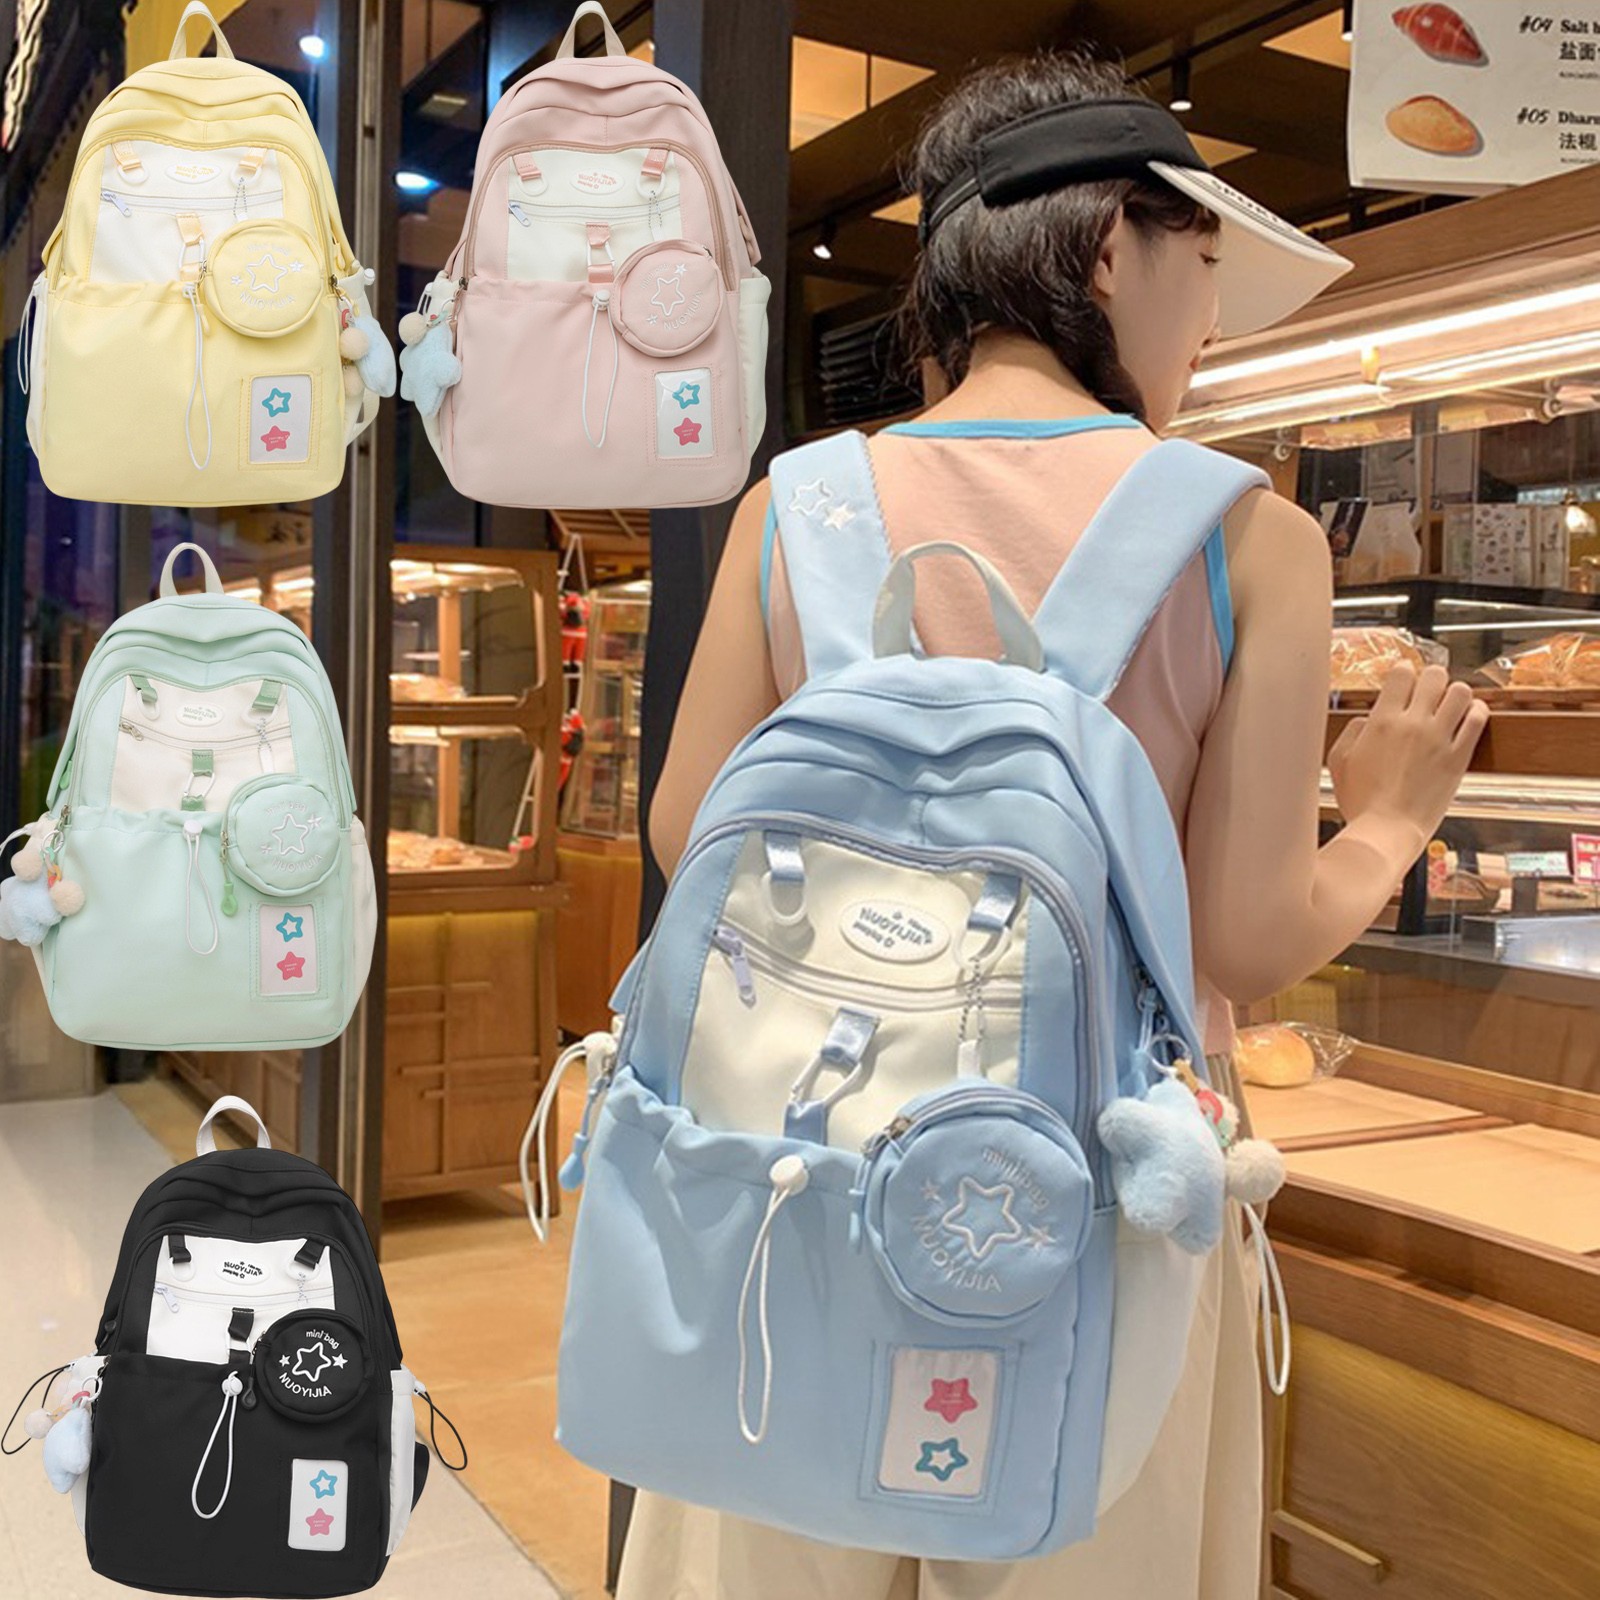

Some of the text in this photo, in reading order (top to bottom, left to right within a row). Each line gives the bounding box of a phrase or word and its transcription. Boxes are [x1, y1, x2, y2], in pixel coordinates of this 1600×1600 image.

[1560, 19, 1588, 34] Salt
[1517, 107, 1550, 125] #05
[859, 907, 923, 946] NUOYIJIA
[912, 1214, 1003, 1293] NUOYIJIA
[223, 1261, 259, 1277] NUOYIJIA
[305, 1329, 340, 1350] mini bag
[278, 1372, 333, 1398] NUOYIJIA
